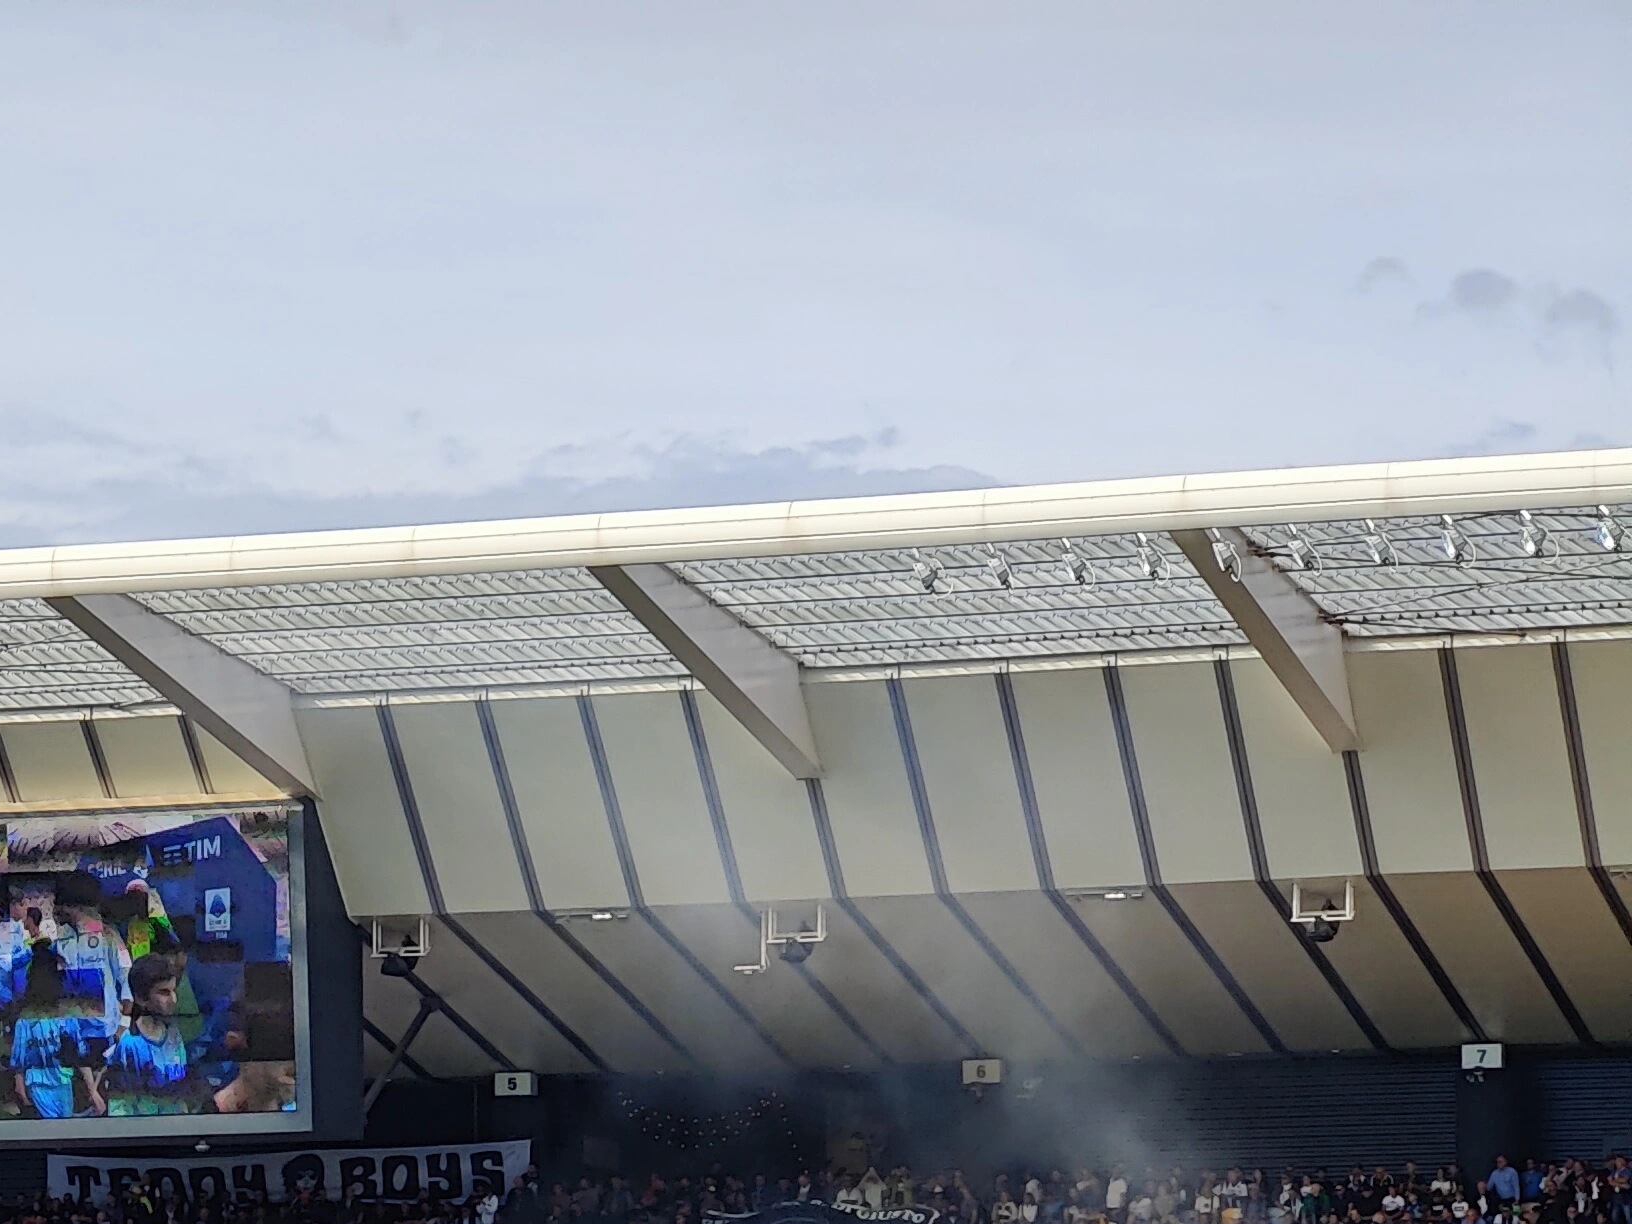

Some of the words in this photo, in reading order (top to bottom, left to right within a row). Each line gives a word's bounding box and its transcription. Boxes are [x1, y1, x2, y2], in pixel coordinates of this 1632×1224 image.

[183, 835, 221, 862] TIM
[1476, 1049, 1487, 1064] 7
[976, 1065, 986, 1079] 6
[507, 1077, 517, 1091] 5
[66, 1164, 266, 1203] TEDDY
[340, 1151, 505, 1201] BOYS
